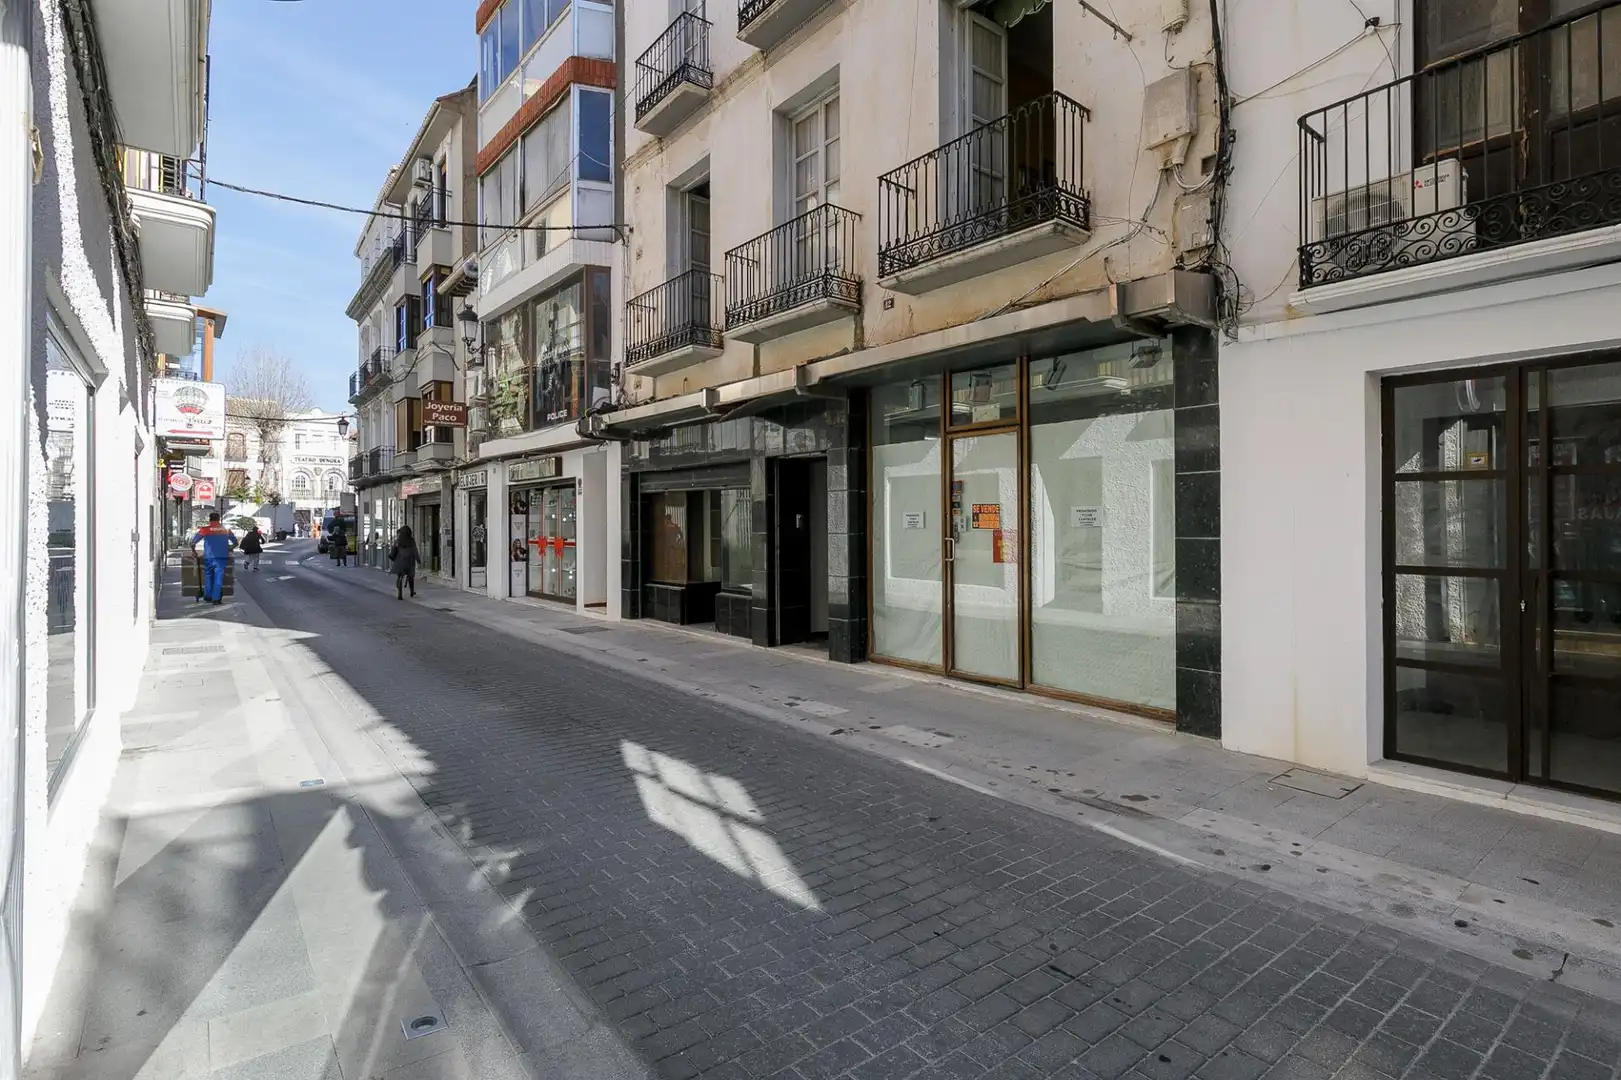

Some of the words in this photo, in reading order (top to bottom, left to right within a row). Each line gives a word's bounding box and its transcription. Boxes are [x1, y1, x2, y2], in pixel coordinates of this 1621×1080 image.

[432, 412, 457, 421] Paco
[547, 409, 567, 421] POLICE
[972, 504, 980, 513] SE
[981, 504, 1000, 513] VENDE
